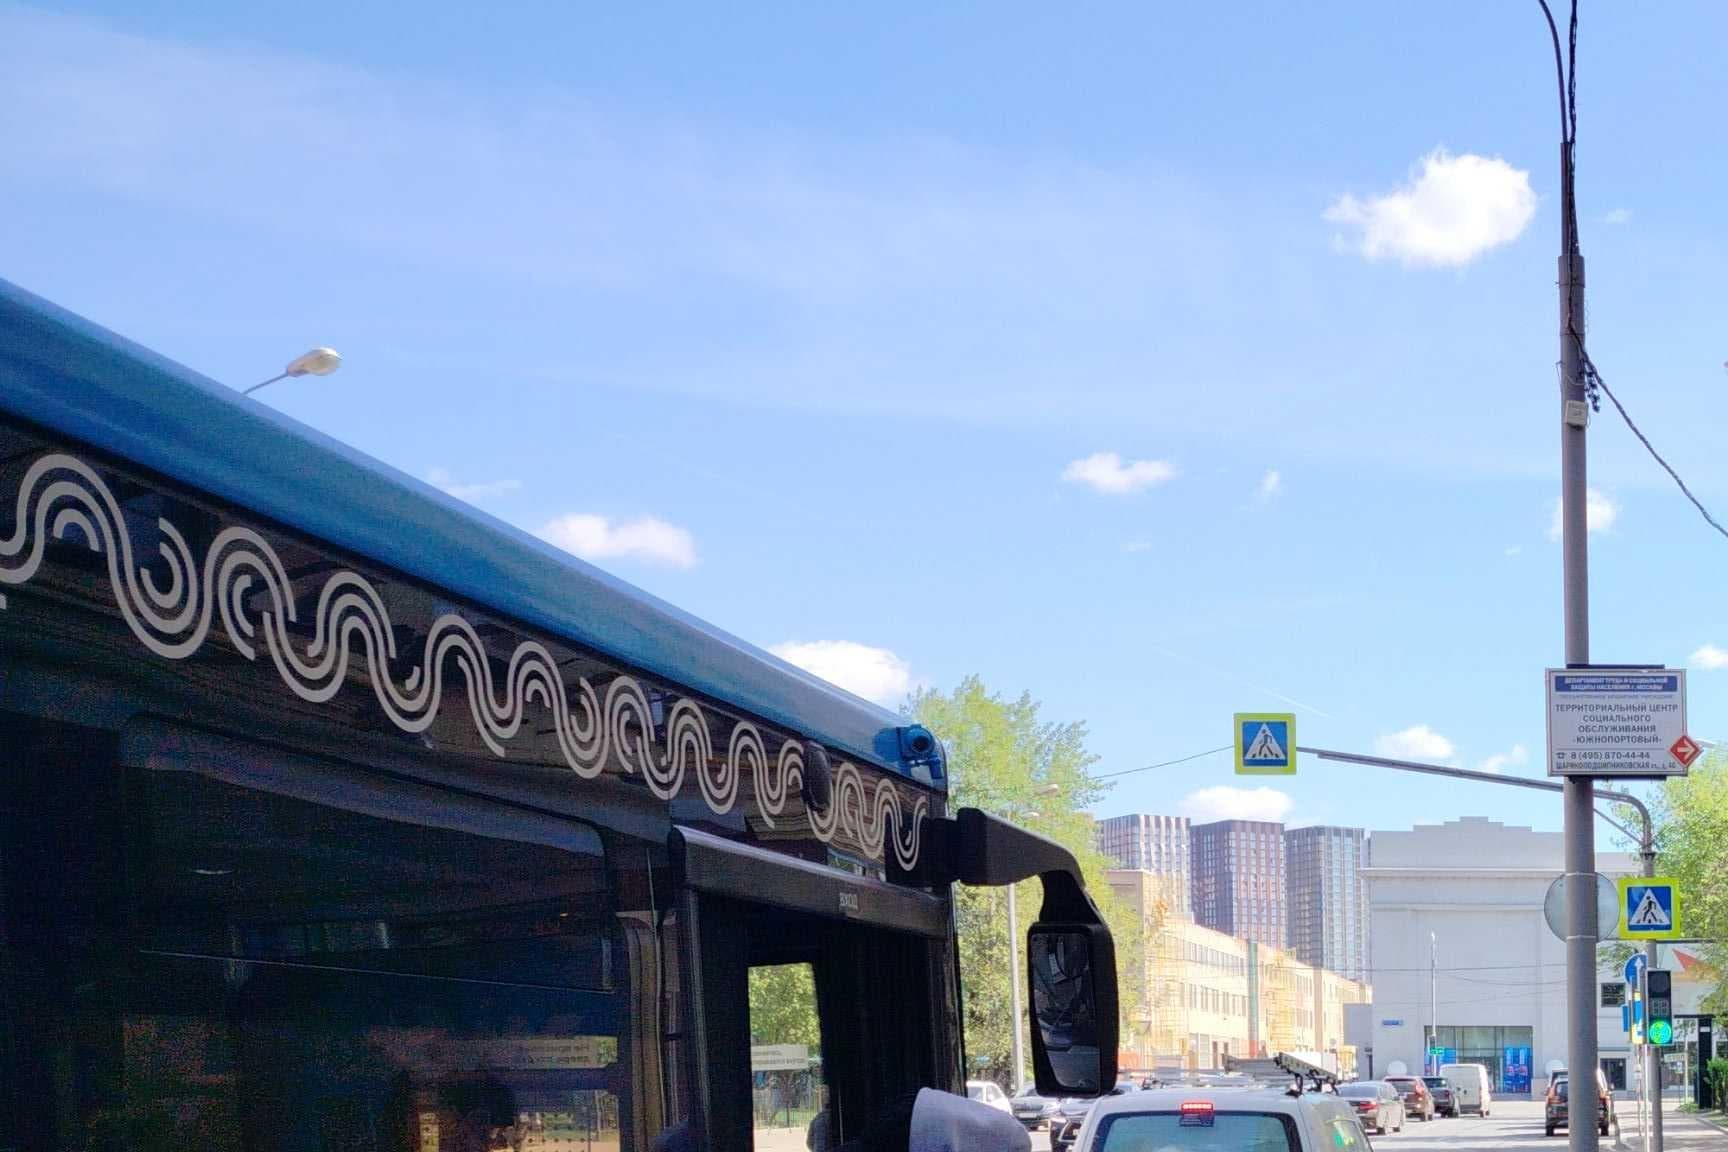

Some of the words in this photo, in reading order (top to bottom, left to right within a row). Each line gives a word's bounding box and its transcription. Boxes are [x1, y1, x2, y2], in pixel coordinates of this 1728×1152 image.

[1555, 703, 1647, 712] ТЕРРИТОРИАЛЬНЫЙ
[1649, 704, 1678, 714] ЦЕНТР
[1582, 714, 1651, 723] СОЦИАЛЬНОГО
[1578, 725, 1656, 733] ОБСЛУЖИВАНИЯ
